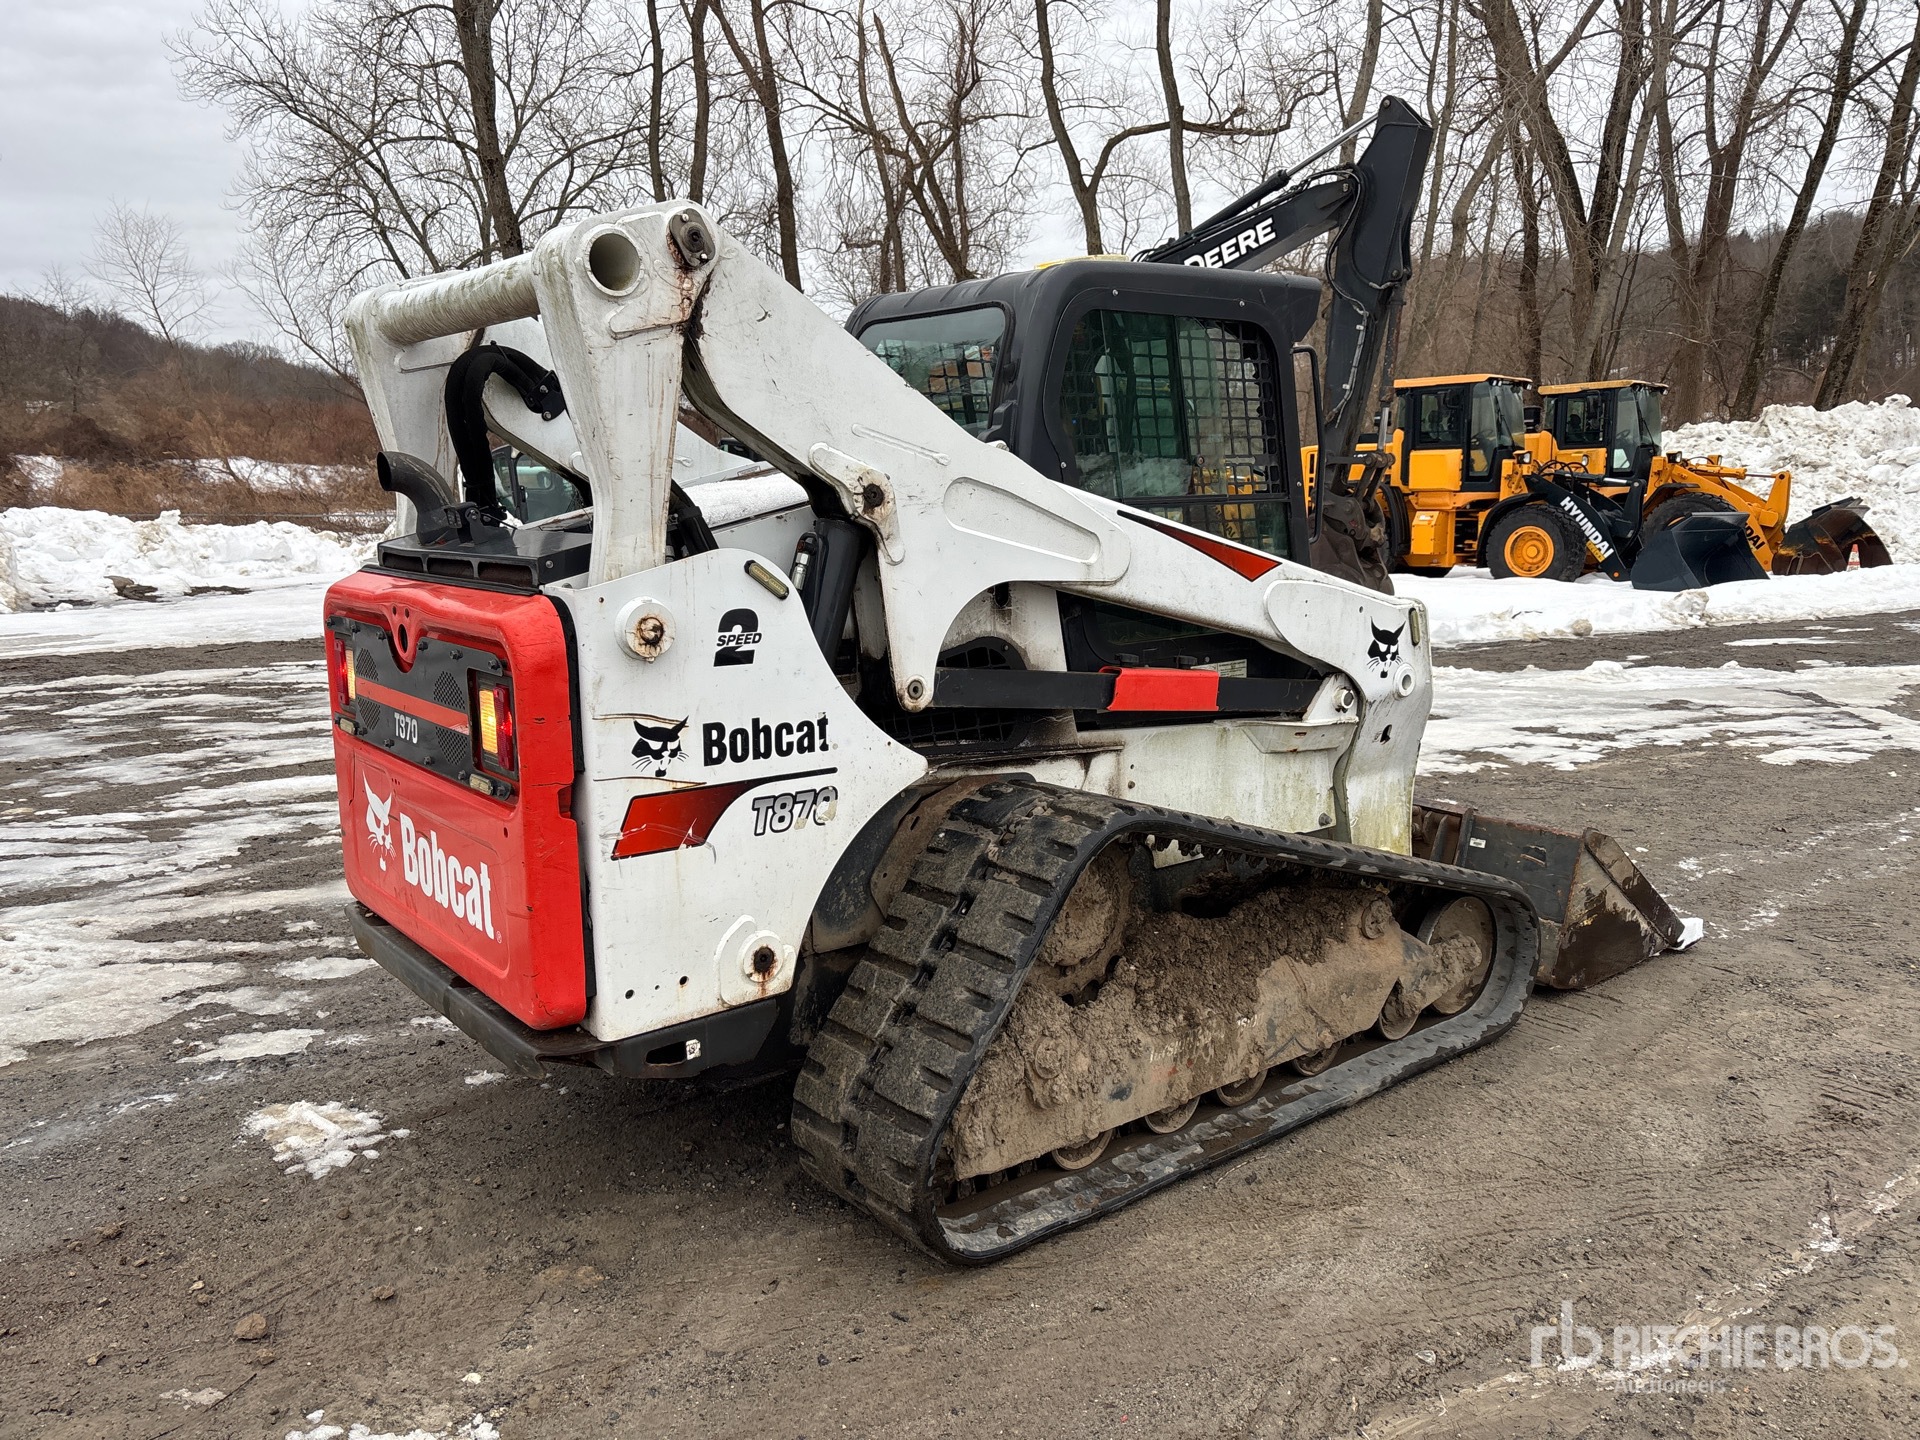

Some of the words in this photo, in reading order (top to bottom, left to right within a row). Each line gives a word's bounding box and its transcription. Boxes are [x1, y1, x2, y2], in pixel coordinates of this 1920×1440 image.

[1560, 496, 1614, 559] HYUNDAI
[1744, 522, 1766, 550] DAI
[713, 608, 759, 667] 2
[716, 632, 762, 647] SPEED
[394, 711, 418, 744] T870
[702, 711, 829, 767] Bobcat
[752, 786, 838, 836] T870
[399, 811, 495, 940] Bobcat
